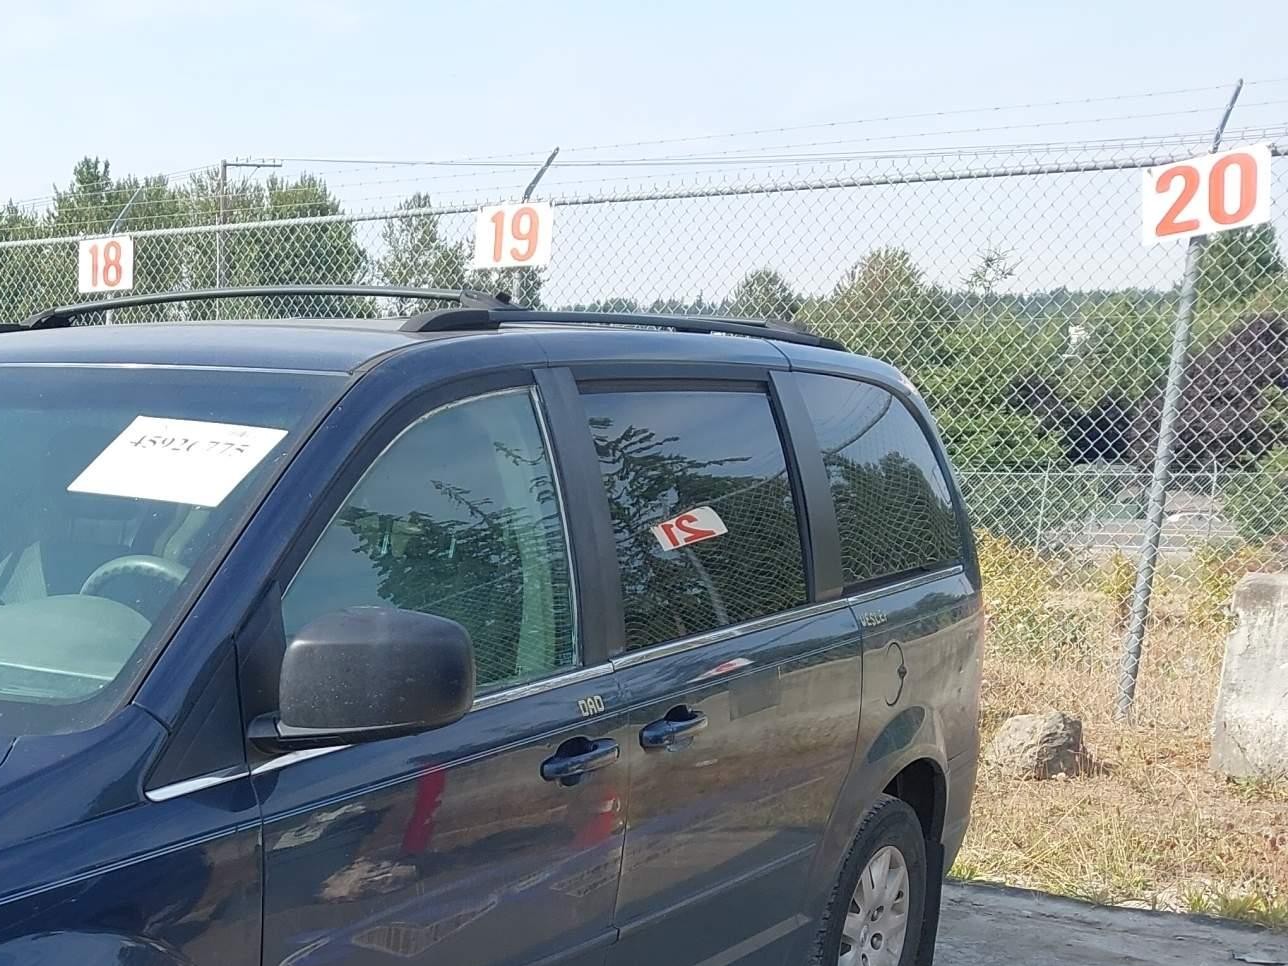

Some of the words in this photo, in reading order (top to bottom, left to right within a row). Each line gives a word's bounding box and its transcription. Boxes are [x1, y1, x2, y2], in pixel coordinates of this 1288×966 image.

[1155, 152, 1258, 237] 20
[490, 206, 540, 263] 19
[88, 240, 124, 288] 18
[577, 695, 605, 717] DAD
